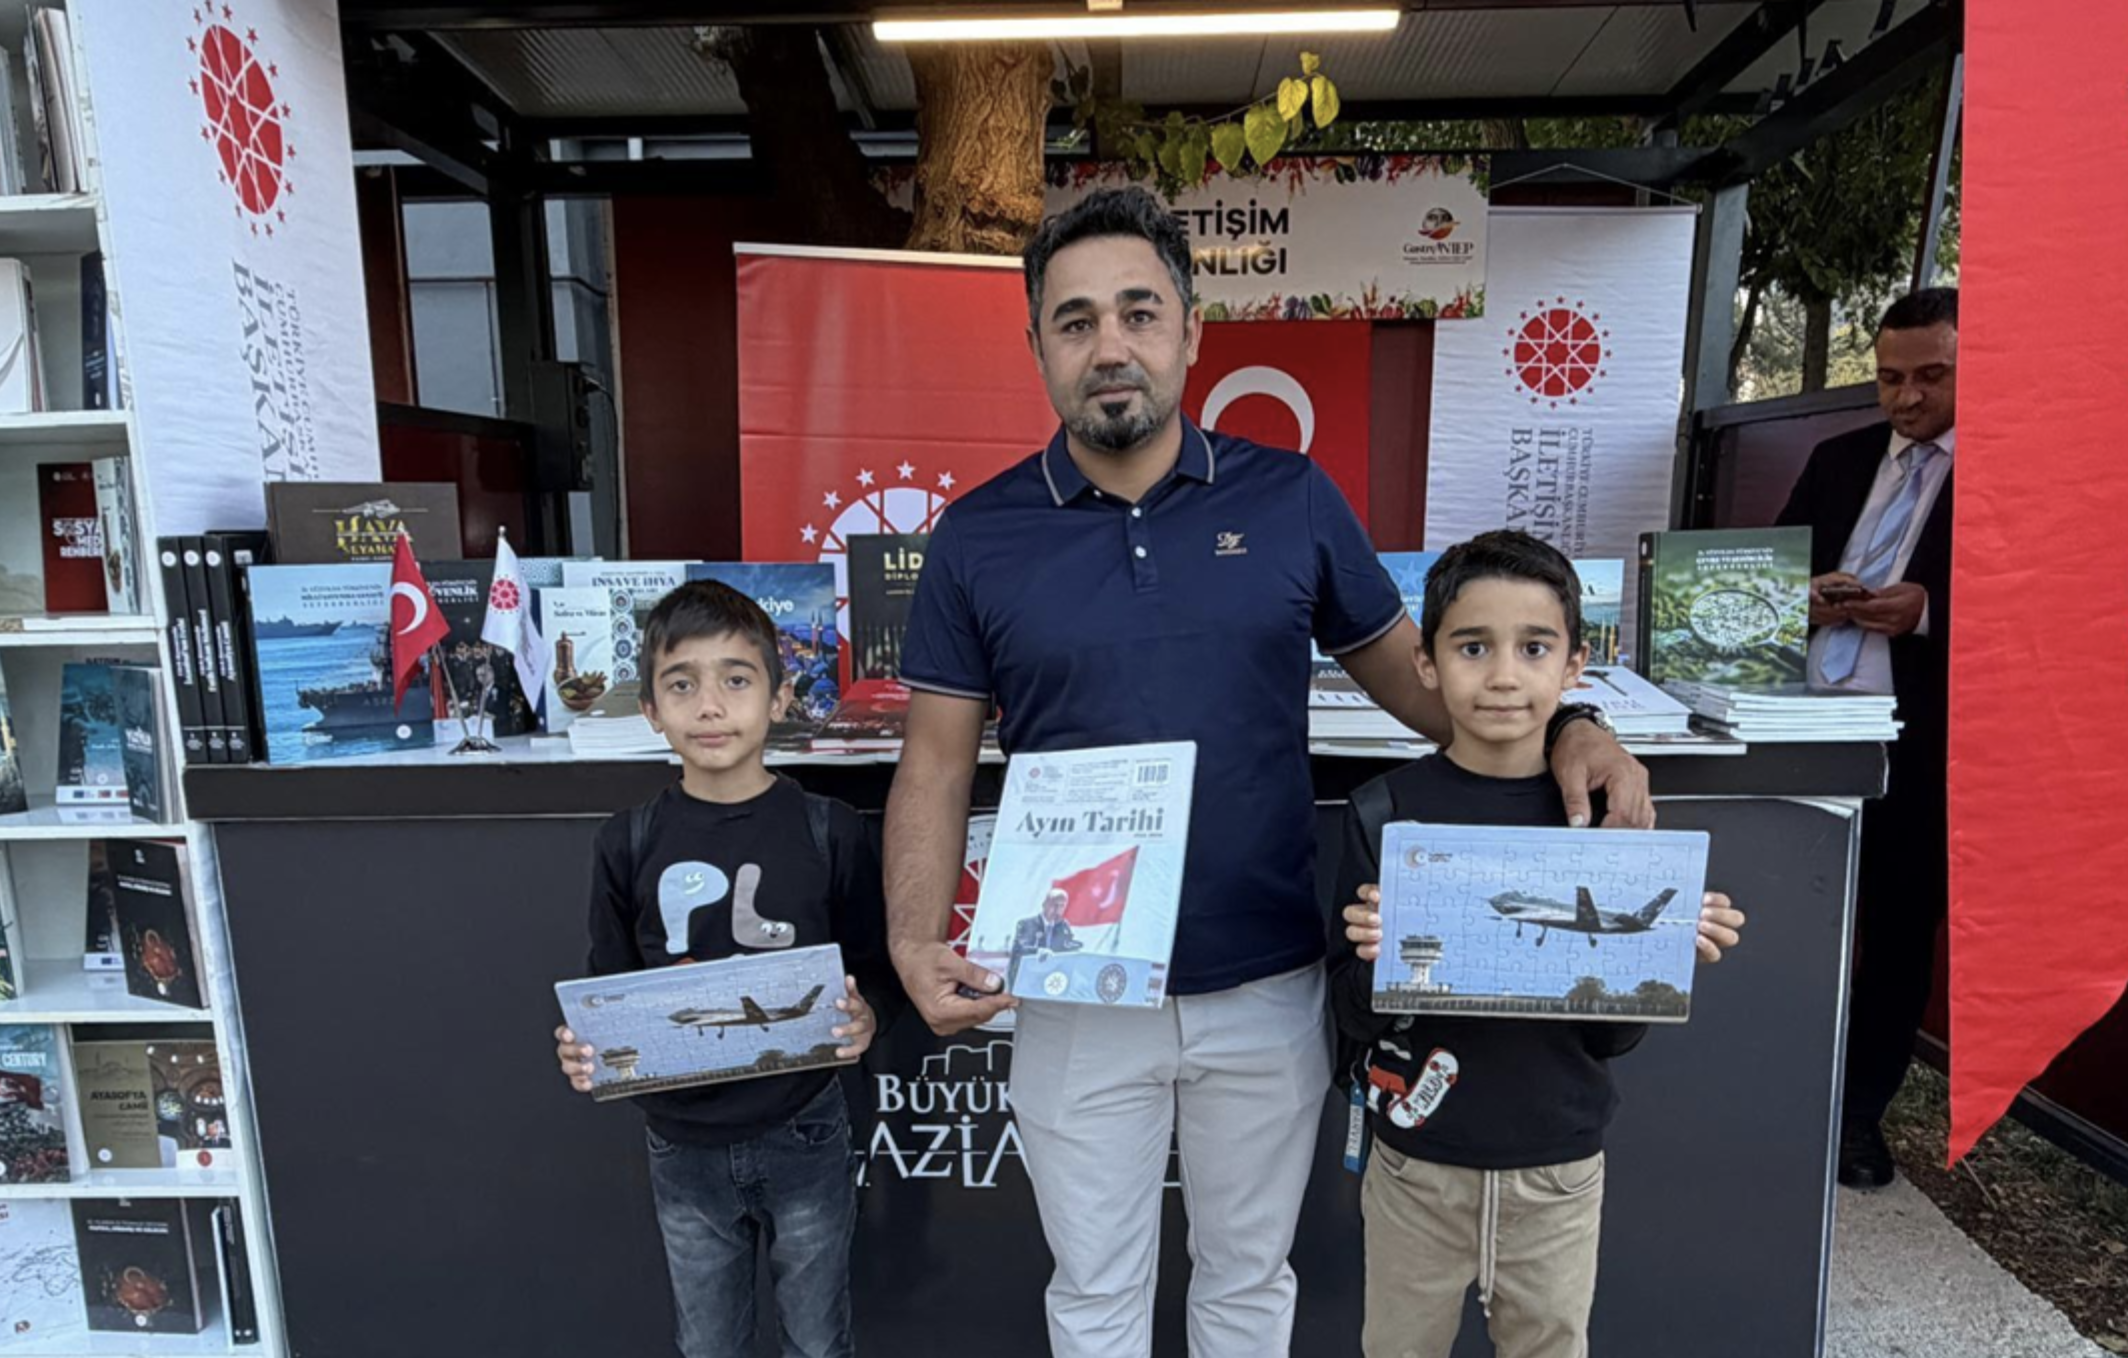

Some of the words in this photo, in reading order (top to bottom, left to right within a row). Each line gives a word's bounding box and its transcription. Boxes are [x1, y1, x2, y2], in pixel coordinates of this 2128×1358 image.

[1579, 428, 1594, 481] TÜRKİYE
[884, 546, 924, 570] LİD
[1015, 810, 1076, 838] Ayın
[1082, 807, 1165, 832] Tarihi
[1, 1051, 47, 1067] CENTURY
